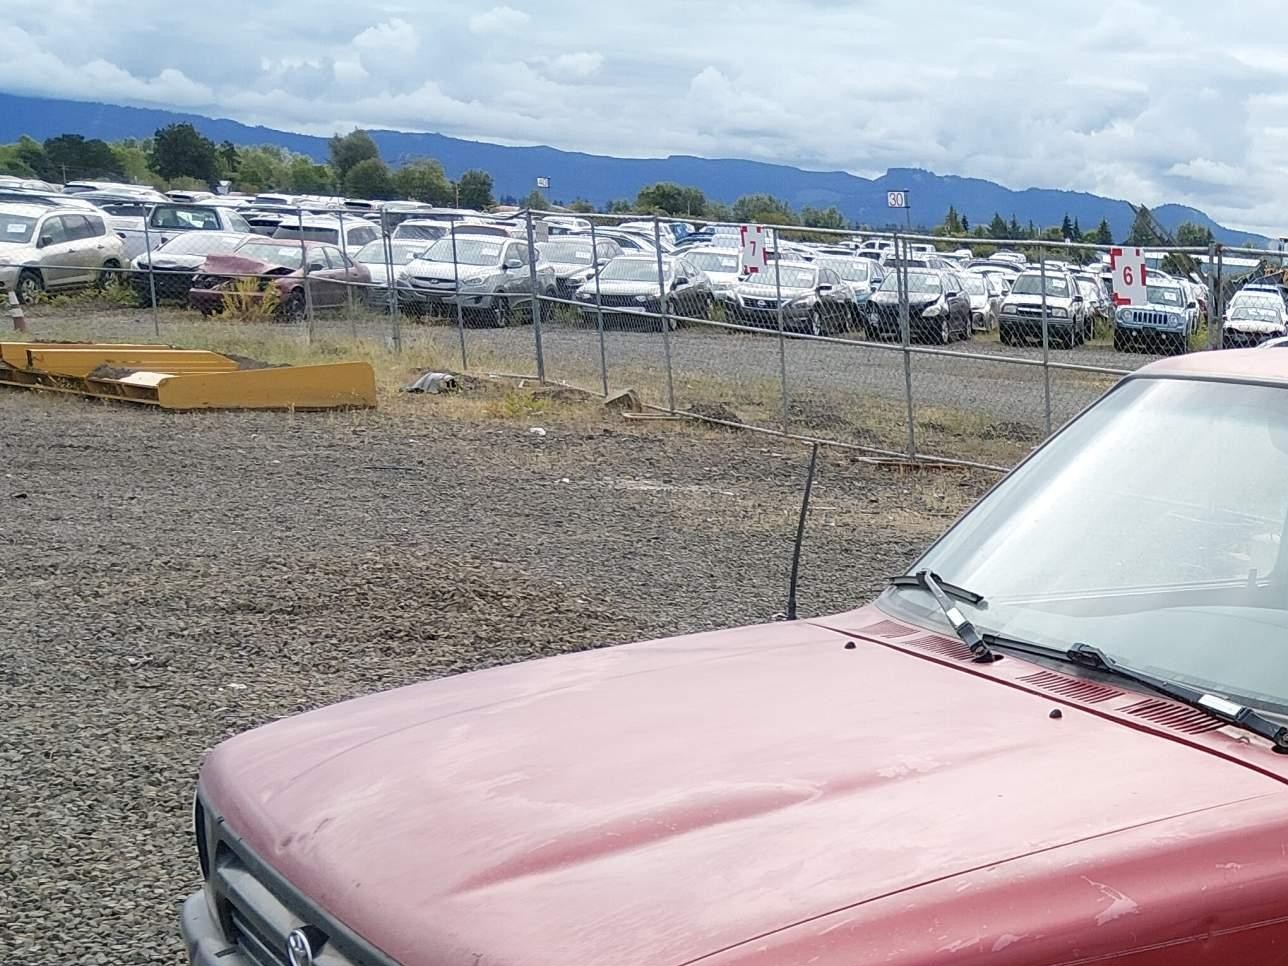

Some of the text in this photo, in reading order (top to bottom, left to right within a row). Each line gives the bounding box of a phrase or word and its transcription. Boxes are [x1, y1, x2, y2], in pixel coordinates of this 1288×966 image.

[889, 192, 904, 206] 30
[750, 241, 756, 256] 7
[1123, 266, 1133, 286] 6
